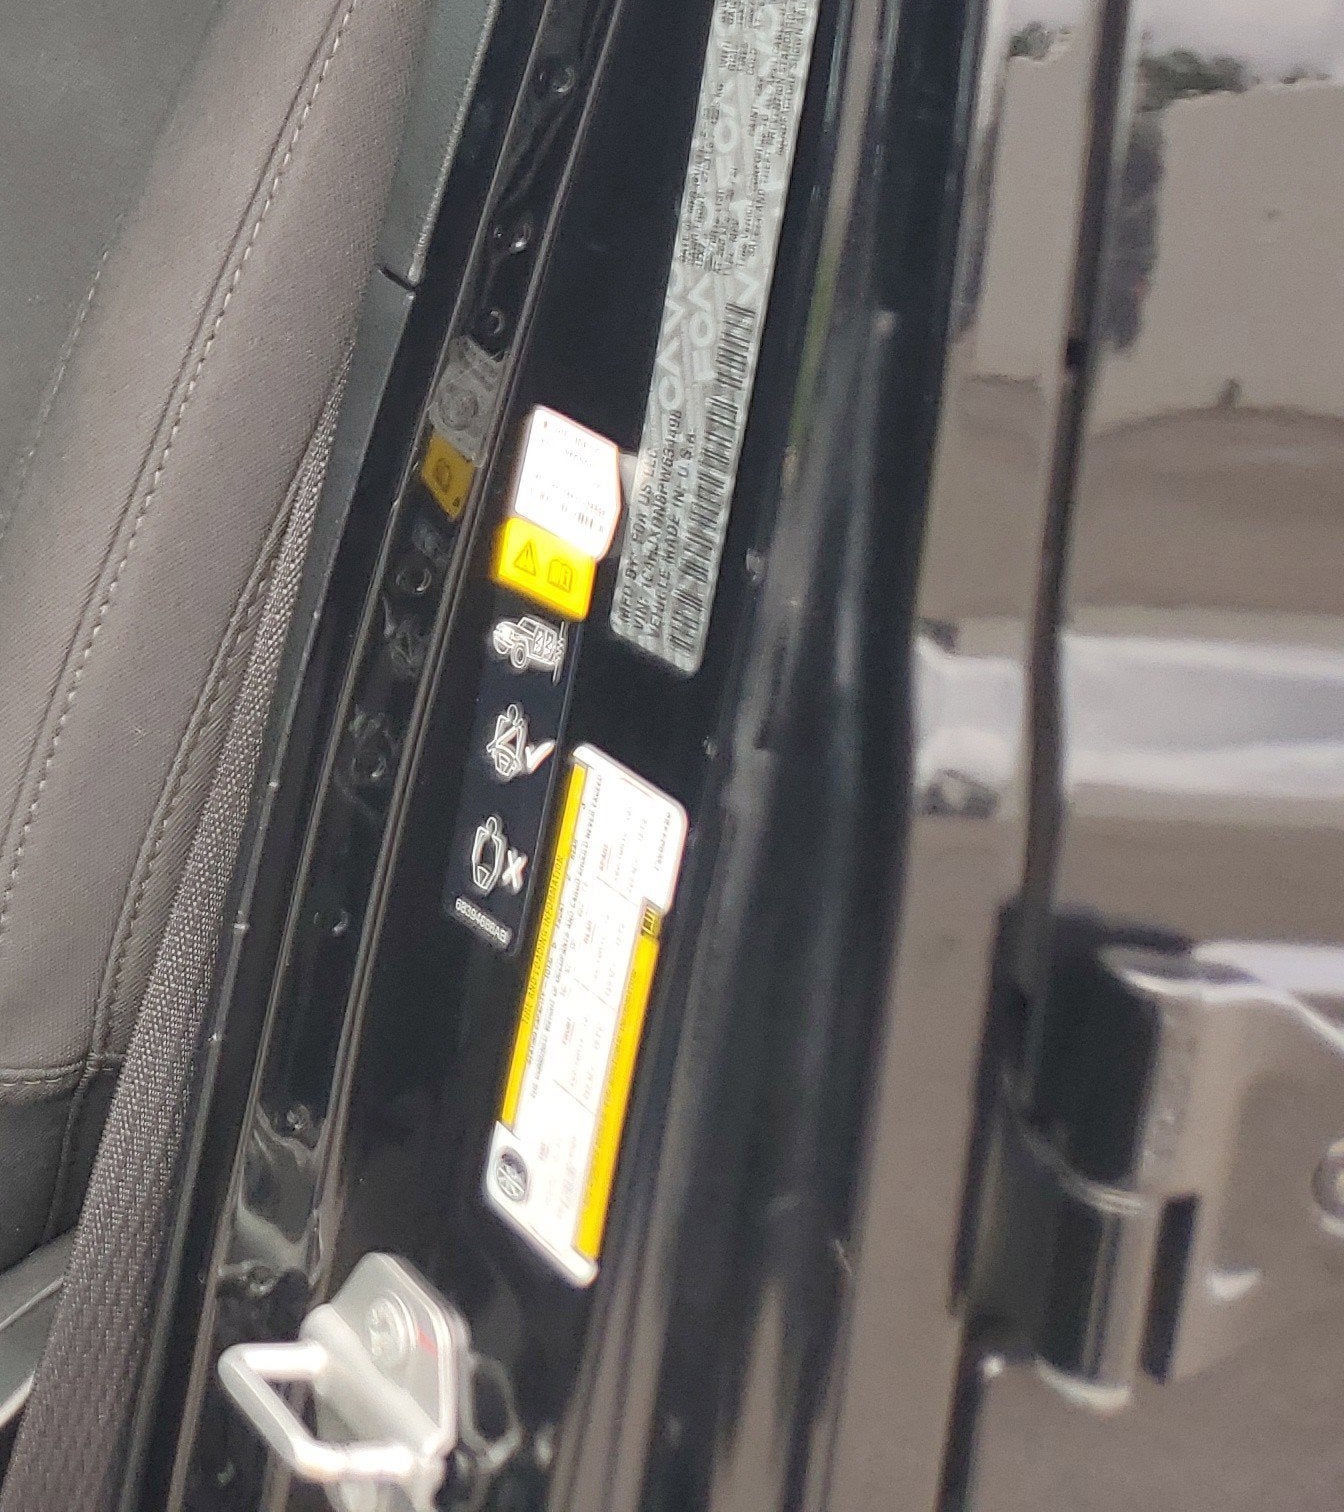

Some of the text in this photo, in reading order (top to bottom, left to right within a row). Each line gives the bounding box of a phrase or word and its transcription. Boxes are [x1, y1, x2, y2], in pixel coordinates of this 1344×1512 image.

[637, 479, 652, 509] US
[646, 564, 671, 644] VEHICLE
[660, 510, 681, 568] MADE
